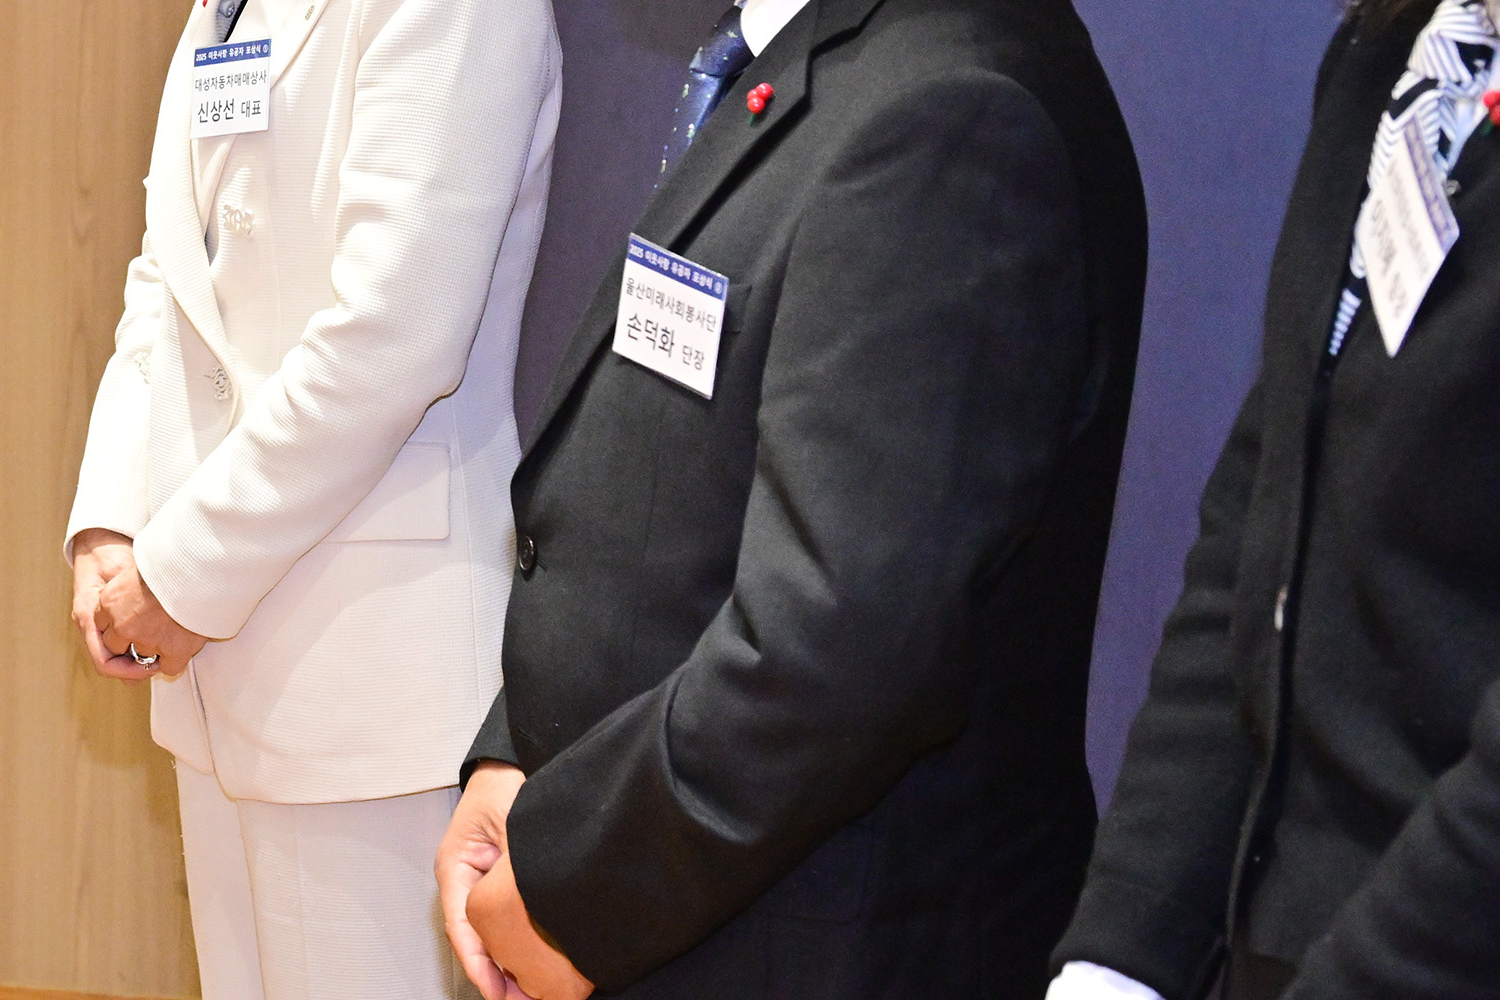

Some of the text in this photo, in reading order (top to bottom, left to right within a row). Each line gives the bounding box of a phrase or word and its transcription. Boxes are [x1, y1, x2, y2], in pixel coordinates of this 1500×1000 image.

[196, 53, 207, 61] 2025
[208, 49, 227, 60] 이웃사랑
[229, 47, 244, 57] 유공자
[246, 44, 261, 54] 포상식
[195, 70, 267, 92] 대성자동차매매상사
[198, 98, 261, 123] 신상선 대표
[644, 250, 670, 271] 이웃사랑
[625, 277, 717, 333] 울산미래사회봉사단
[627, 312, 705, 371] 손덕화 단장
